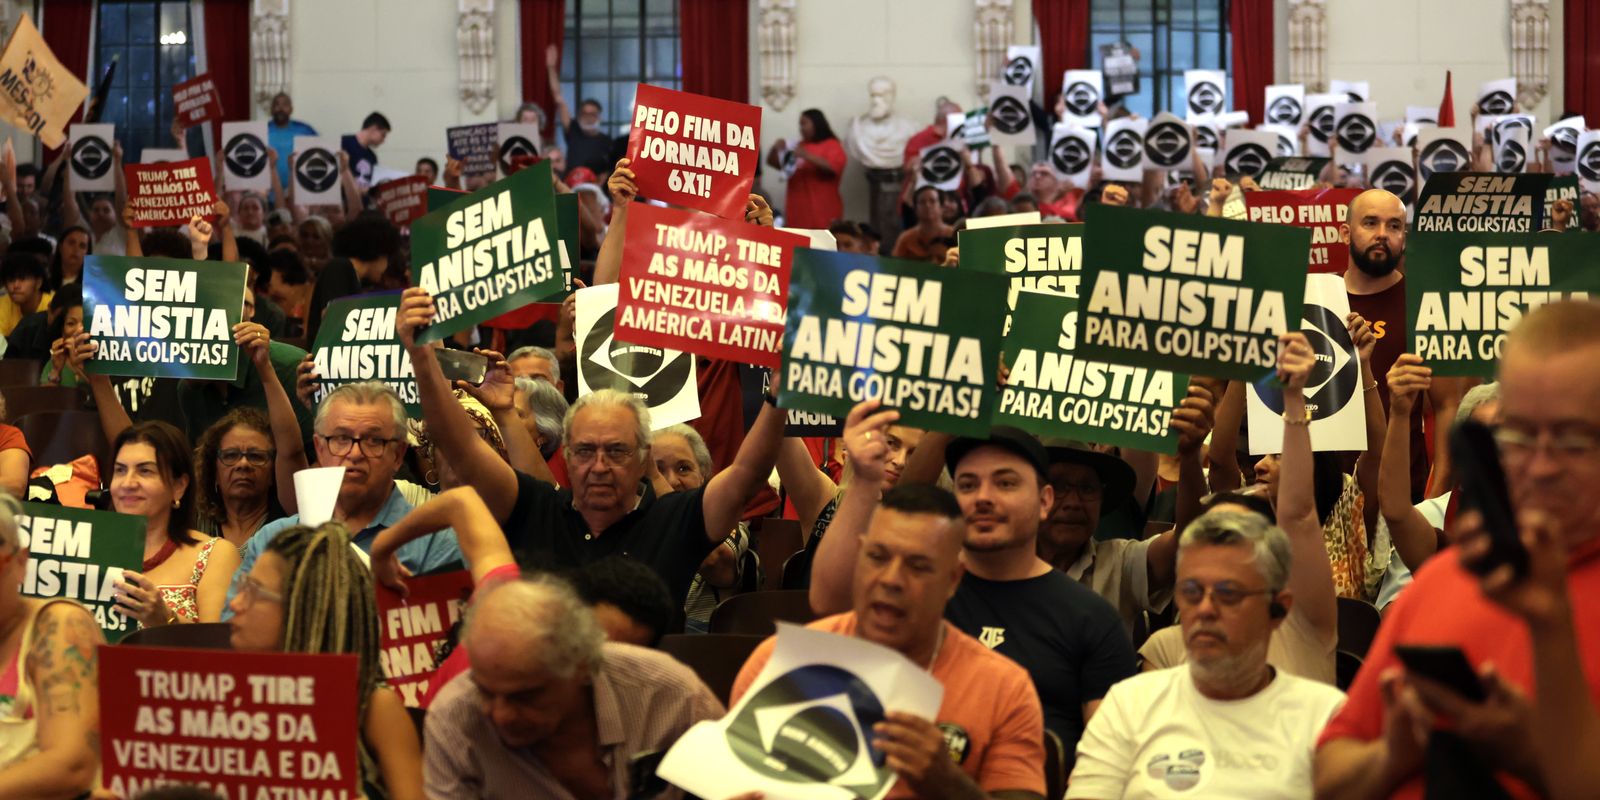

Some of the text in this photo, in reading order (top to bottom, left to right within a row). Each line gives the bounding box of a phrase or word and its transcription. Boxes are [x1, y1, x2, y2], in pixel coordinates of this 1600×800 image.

[634, 105, 755, 150] PELO FIM DA
[137, 167, 197, 183] TRUMP, TIRE
[640, 136, 739, 176] JORNADA
[133, 191, 211, 208] VENEZUELA E DA
[140, 180, 200, 195] AS MÃOS DA
[668, 169, 712, 198] 6X1!
[1457, 176, 1516, 193] SEM
[134, 209, 174, 221] AMÉRICA
[446, 190, 513, 249] SEM
[1250, 204, 1349, 224] PELO FIM D
[1418, 216, 1452, 232] PARA
[1457, 216, 1531, 233] GOLPSTAS!
[1420, 195, 1532, 216] ANISTIA
[419, 217, 550, 296] ANISTIA
[655, 223, 782, 268] TRUMP, TIRE
[1004, 236, 1082, 273] SEM
[1143, 225, 1244, 281] SEM
[125, 268, 197, 303] SEM
[648, 252, 781, 296] AS MÃOS DA
[1460, 246, 1550, 287] SEM
[429, 292, 463, 325] ARA
[463, 254, 554, 311] GOLPSTAS!
[629, 277, 746, 318] VENEZUELA
[842, 269, 942, 327] SEM
[1087, 270, 1288, 336] ANISTIA
[90, 304, 230, 341] ANISTIA
[342, 307, 397, 341] SEM
[619, 305, 713, 342] AMÉRICA
[1085, 316, 1148, 351] PARA
[136, 341, 229, 366] GOLPSTAS!
[311, 345, 416, 379] ANISTIA
[790, 315, 984, 385] ANISTIA
[1415, 335, 1472, 361] PARA
[787, 362, 982, 419] PARA GOLPSTAS!
[1006, 348, 1173, 407] ANISTIA
[1000, 389, 1171, 437] PARA GOLPSTAS!
[15, 514, 92, 558] SEM
[18, 558, 126, 602] ISTIA
[387, 602, 442, 640] FIM
[135, 669, 315, 707] TRUMP, TIRE
[135, 704, 317, 742] AS MÃOS DA
[113, 739, 341, 780] VENEZUELA E DA
